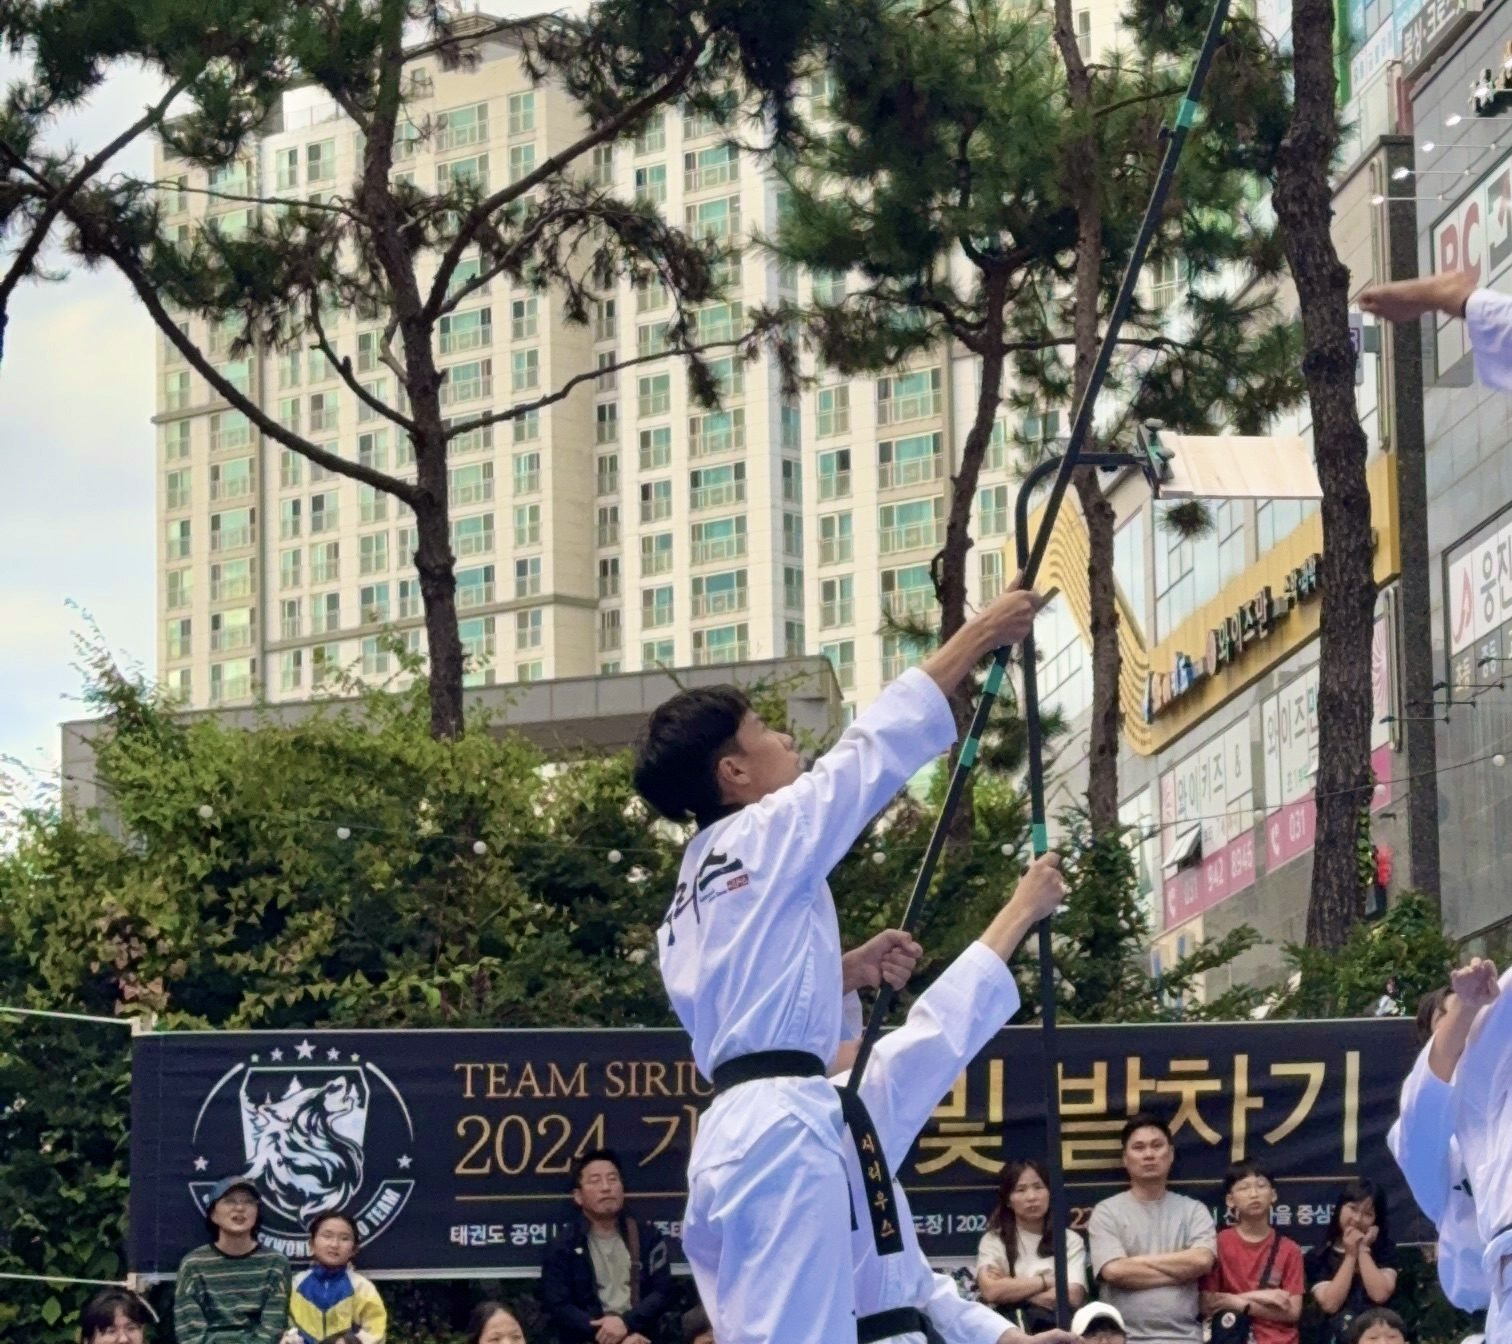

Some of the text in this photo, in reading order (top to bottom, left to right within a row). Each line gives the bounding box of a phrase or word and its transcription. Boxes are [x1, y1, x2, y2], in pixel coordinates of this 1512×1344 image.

[453, 1056, 716, 1100] TEAM SIRIU
[453, 1112, 605, 1176] 2024
[1056, 1049, 1361, 1170] 발차기
[449, 1223, 506, 1246] 태권도
[509, 1222, 548, 1246] 공연
[955, 1215, 988, 1234] 202
